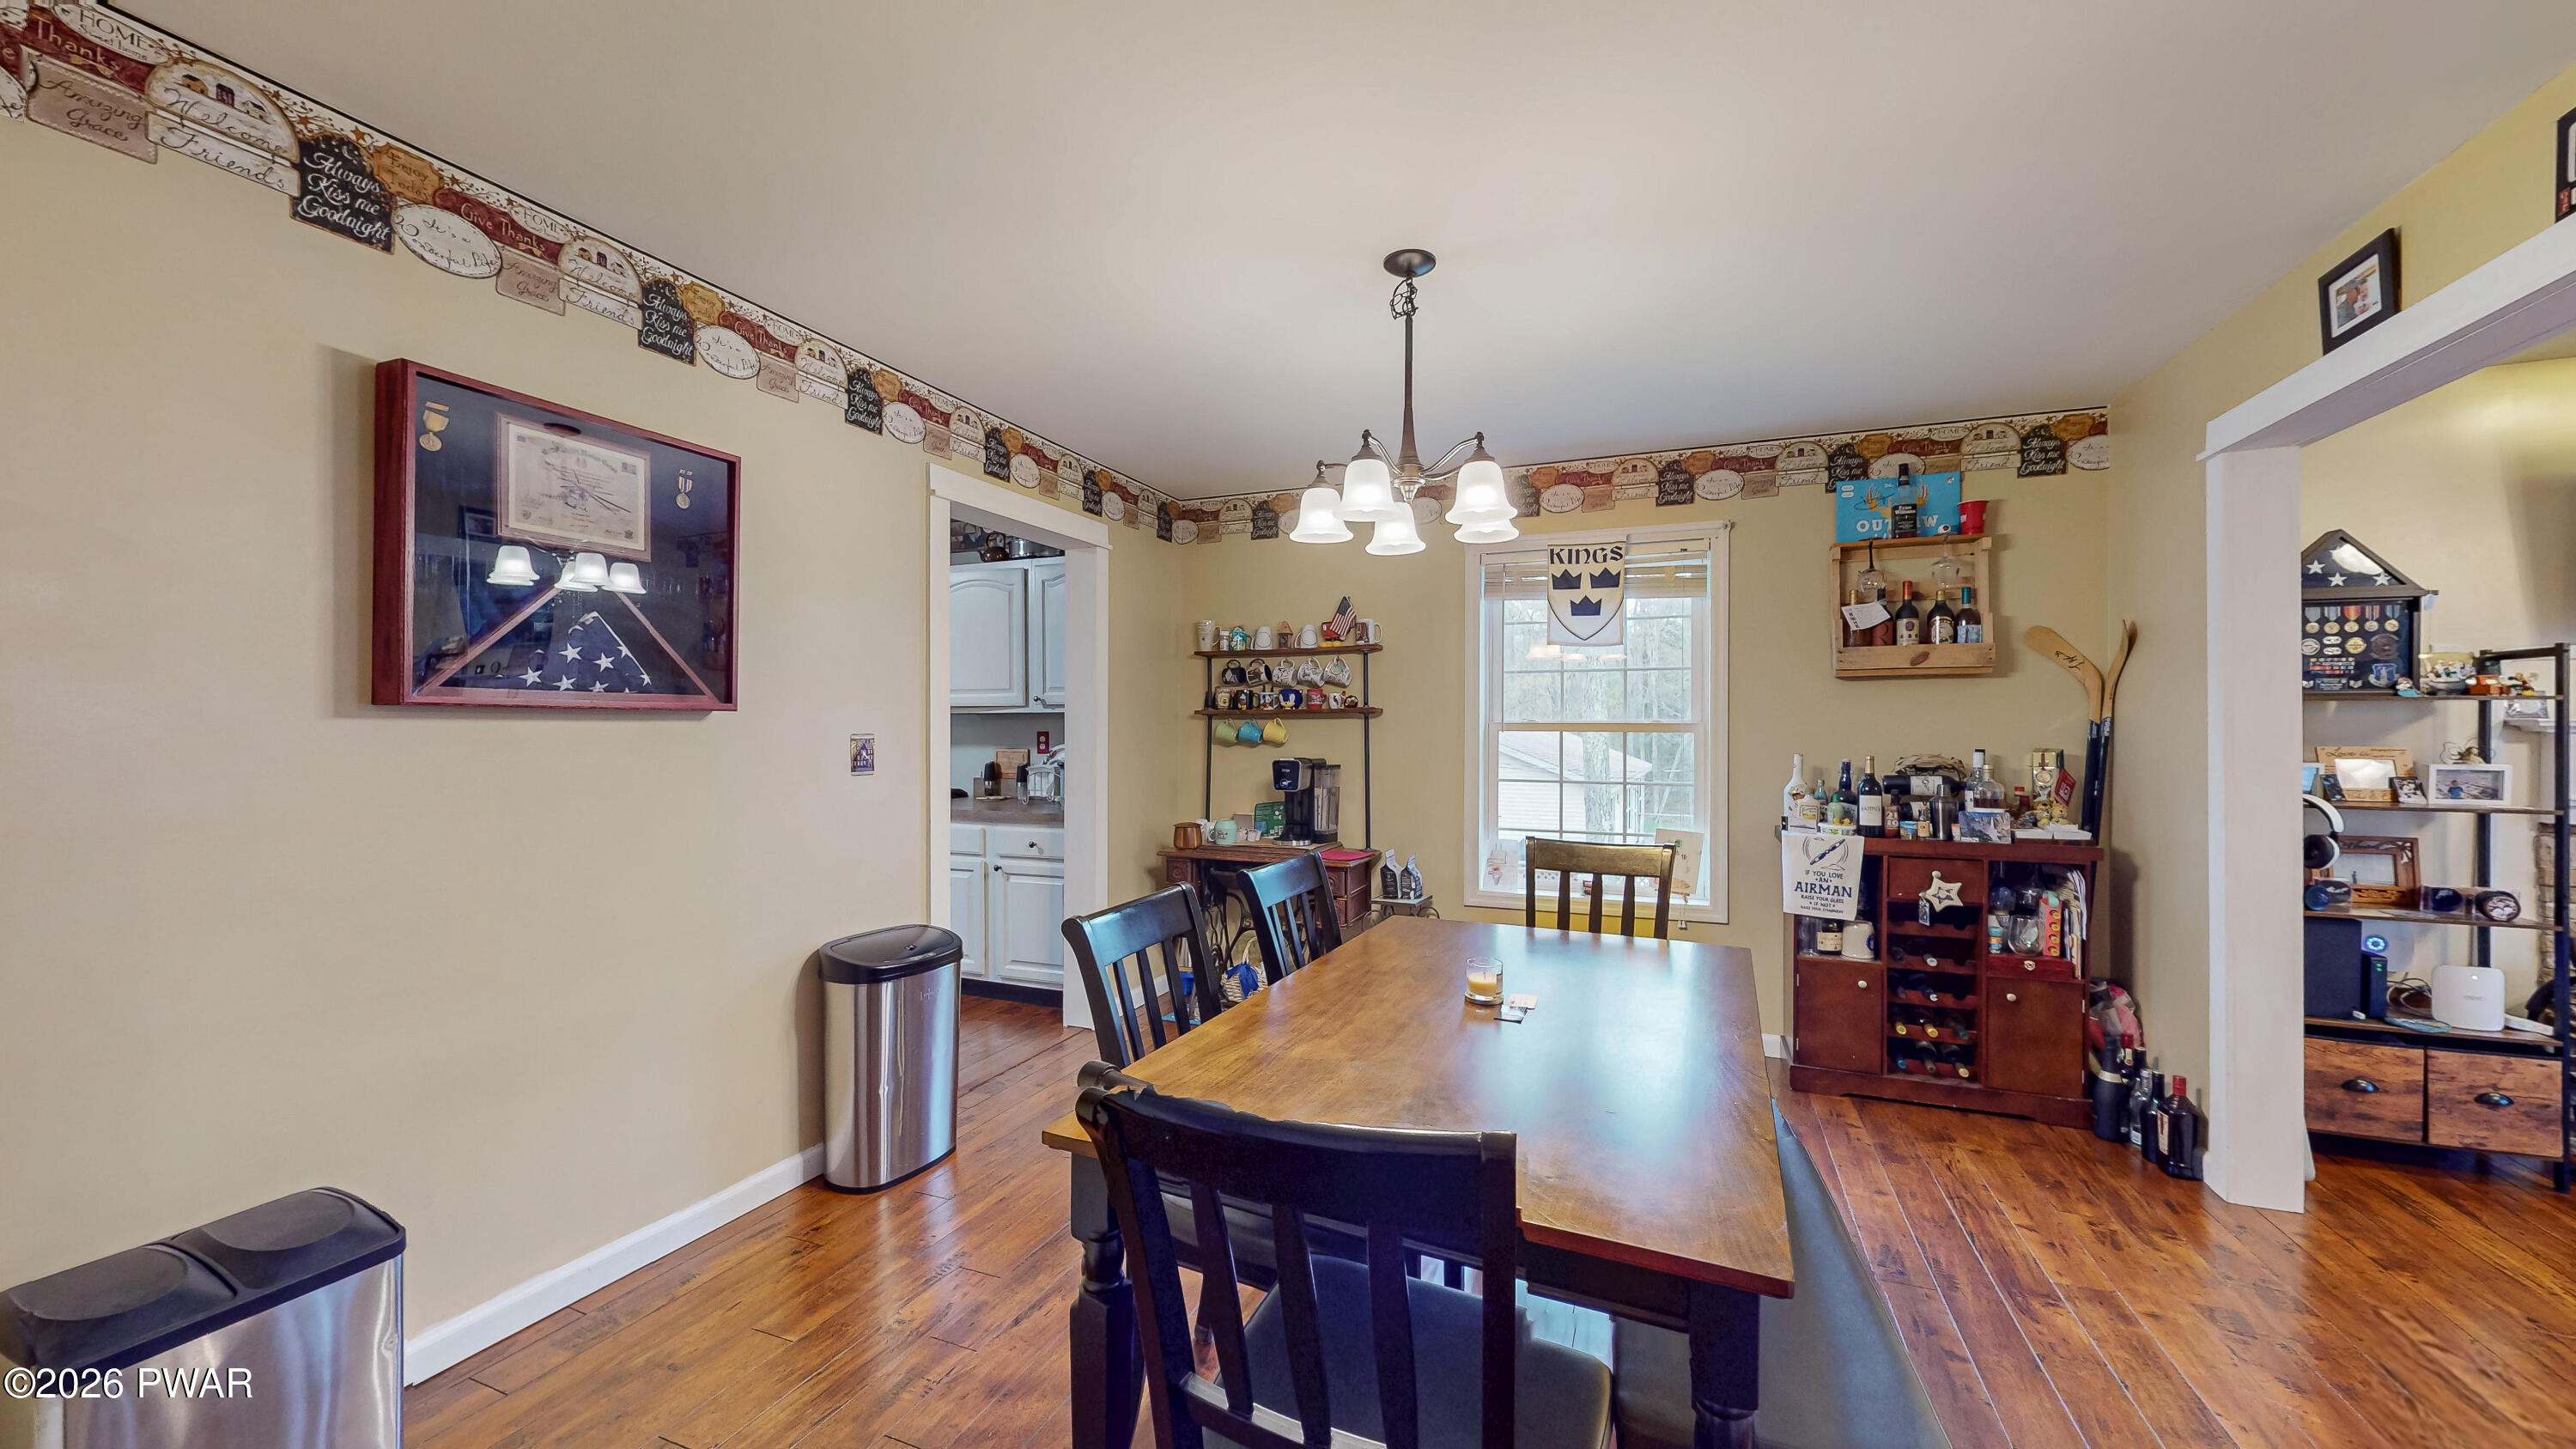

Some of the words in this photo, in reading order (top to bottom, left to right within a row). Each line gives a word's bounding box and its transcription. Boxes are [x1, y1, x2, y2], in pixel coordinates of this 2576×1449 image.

[29, 14, 120, 70] Thanks
[80, 9, 149, 52] HOME
[39, 80, 143, 130] Amazing
[164, 88, 286, 154] Welcome
[67, 108, 128, 142] Grace
[160, 126, 287, 190] Friends
[303, 152, 380, 193] Always
[307, 174, 350, 205] Kiss
[355, 198, 380, 215] me
[297, 195, 391, 240] Goodnight
[460, 202, 493, 230] Give
[500, 217, 545, 251] Thanks
[568, 259, 634, 298] Welcome
[566, 287, 635, 326] Friends
[643, 293, 688, 322] Always
[645, 309, 671, 333] Kiss
[672, 325, 687, 337] me
[641, 326, 694, 356] Goodnight
[734, 320, 755, 341] Give
[756, 330, 787, 353] Thanks
[847, 406, 882, 429] Goodnight
[2020, 460, 2066, 475] Goodnight
[2024, 450, 2045, 462] Kiss
[1549, 545, 1624, 565] KINGS
[1794, 881, 1852, 898] AIRMAN
